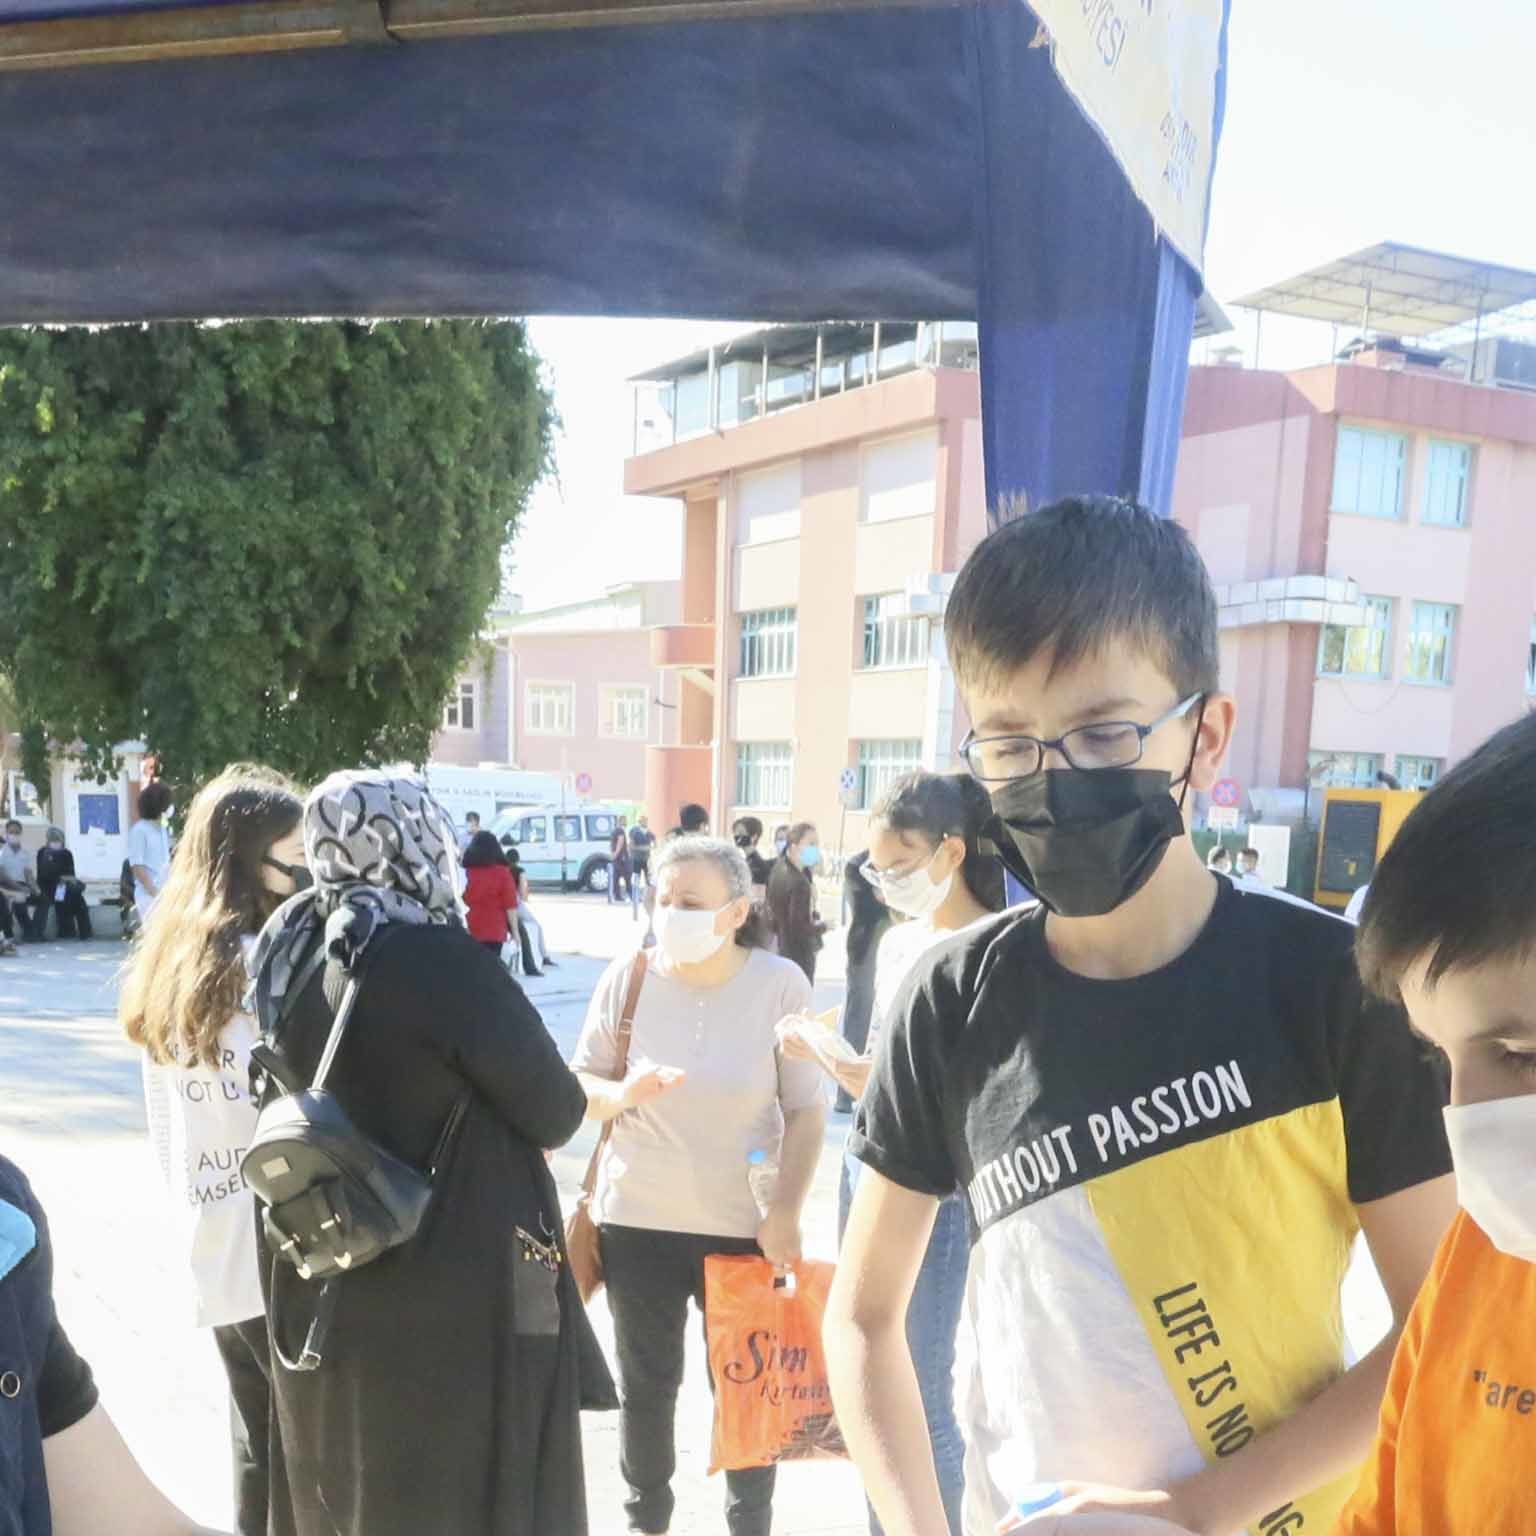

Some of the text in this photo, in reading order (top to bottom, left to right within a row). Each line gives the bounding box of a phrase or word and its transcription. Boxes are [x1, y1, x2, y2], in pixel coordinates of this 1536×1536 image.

[967, 1060, 1252, 1228] WITHOUT PASSION
[724, 1328, 806, 1384] Sim
[1152, 1282, 1222, 1364] LIFE
[1188, 1360, 1237, 1408] IS
